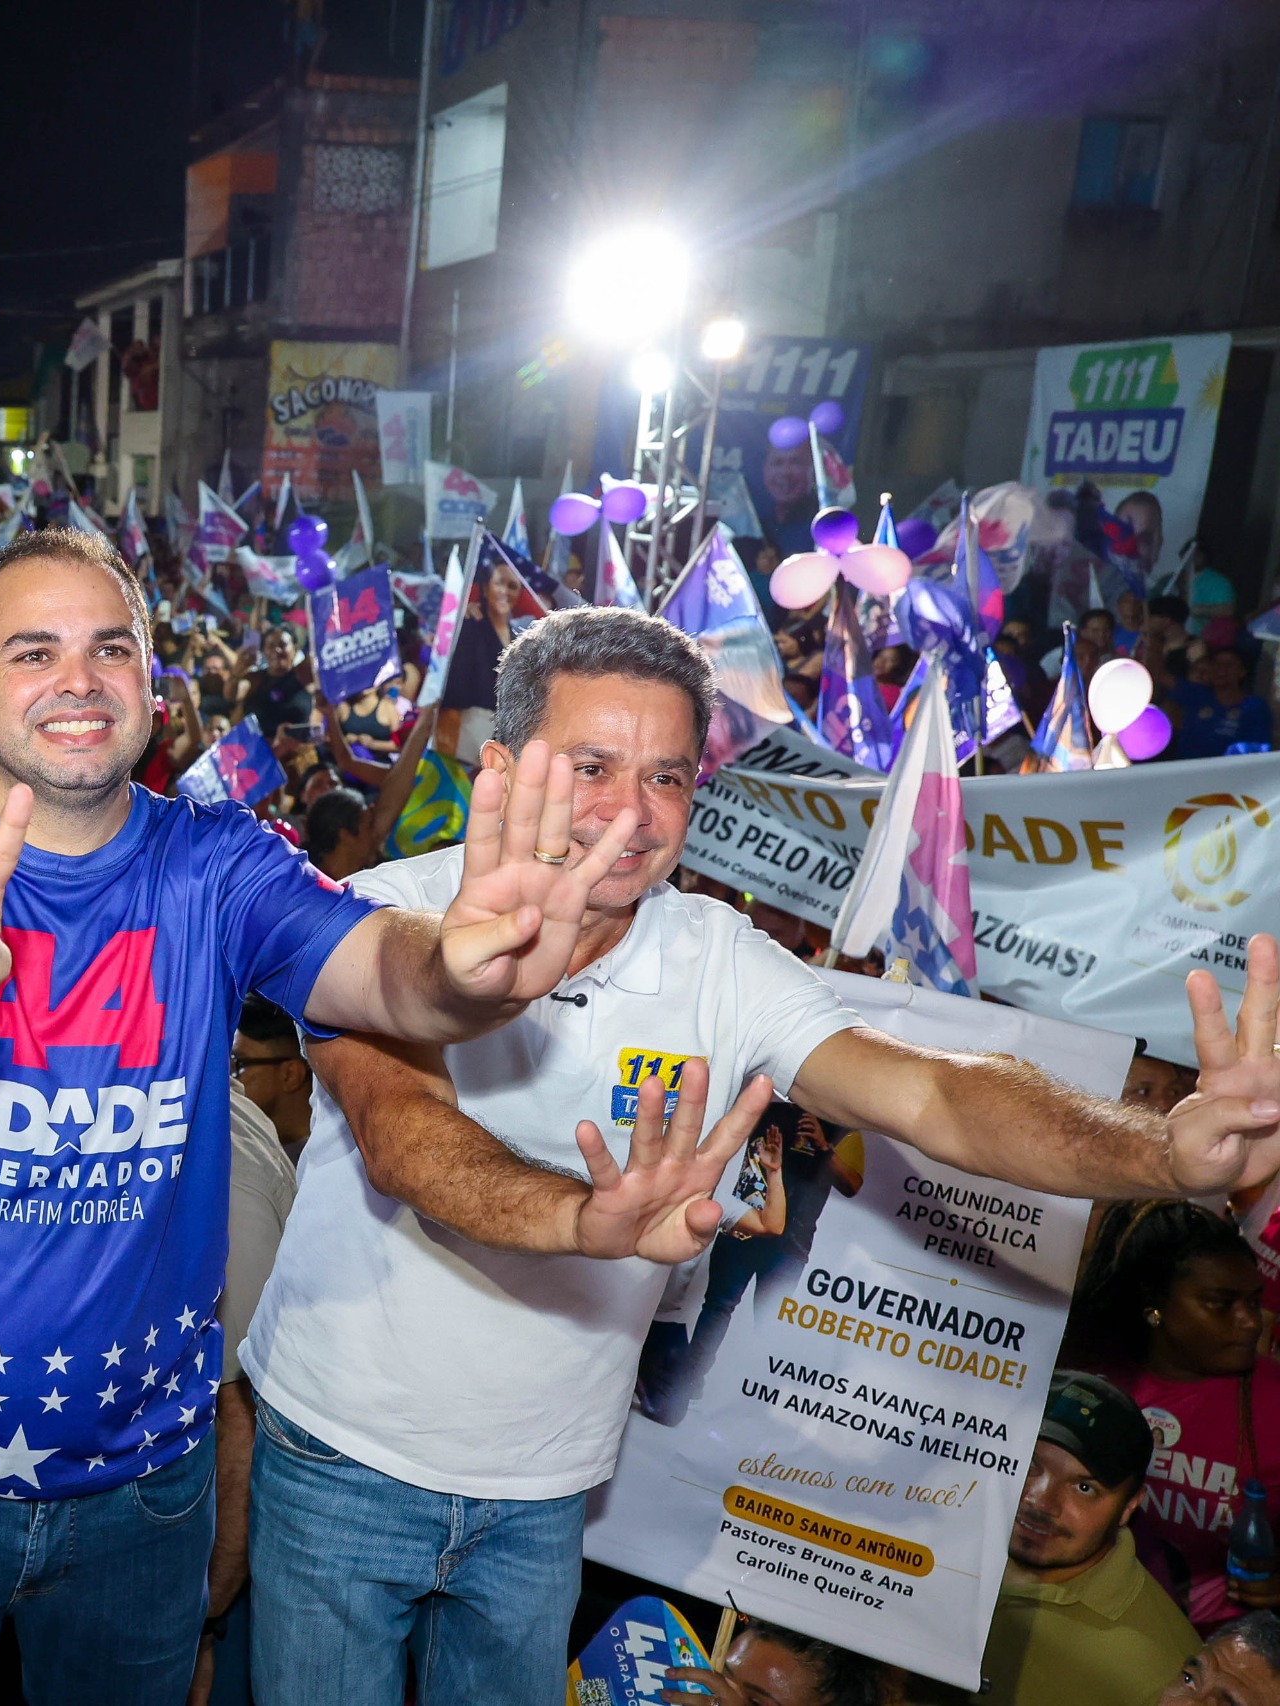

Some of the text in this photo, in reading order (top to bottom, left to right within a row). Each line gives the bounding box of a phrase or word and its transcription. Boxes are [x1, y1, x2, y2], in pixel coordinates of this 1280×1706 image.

[746, 344, 858, 397] 1111
[1084, 355, 1158, 404] 1111
[1052, 418, 1177, 464] TADEU
[326, 586, 381, 635] 44
[322, 620, 390, 661] CIDADE
[737, 824, 810, 873] PELO
[708, 852, 729, 868] Ana
[730, 861, 776, 887] Caroline
[777, 878, 821, 908] Queiroz
[70, 1190, 145, 1225] CORRÊA
[896, 1200, 1038, 1253] APOSTÓLICA
[903, 1175, 1044, 1227] COMUNIDADE
[923, 1233, 997, 1269] PENIEL
[806, 1267, 1026, 1353] GOVERNADOR
[776, 1295, 1028, 1390] ROBERTO CIDADE!
[768, 1355, 1009, 1442] VAMOS AVANÇA PARA
[740, 1377, 1020, 1477] UM AMAZONAS MELHOR!
[737, 1452, 978, 1508] estamos com você!
[734, 1494, 924, 1568] BAIRRO SANTO ANTÔNIO
[719, 1519, 915, 1598] Pastores Bruno & Ana
[735, 1549, 885, 1611] Caroline Queiroz
[609, 1626, 621, 1638] O
[614, 1643, 633, 1684] CARA
